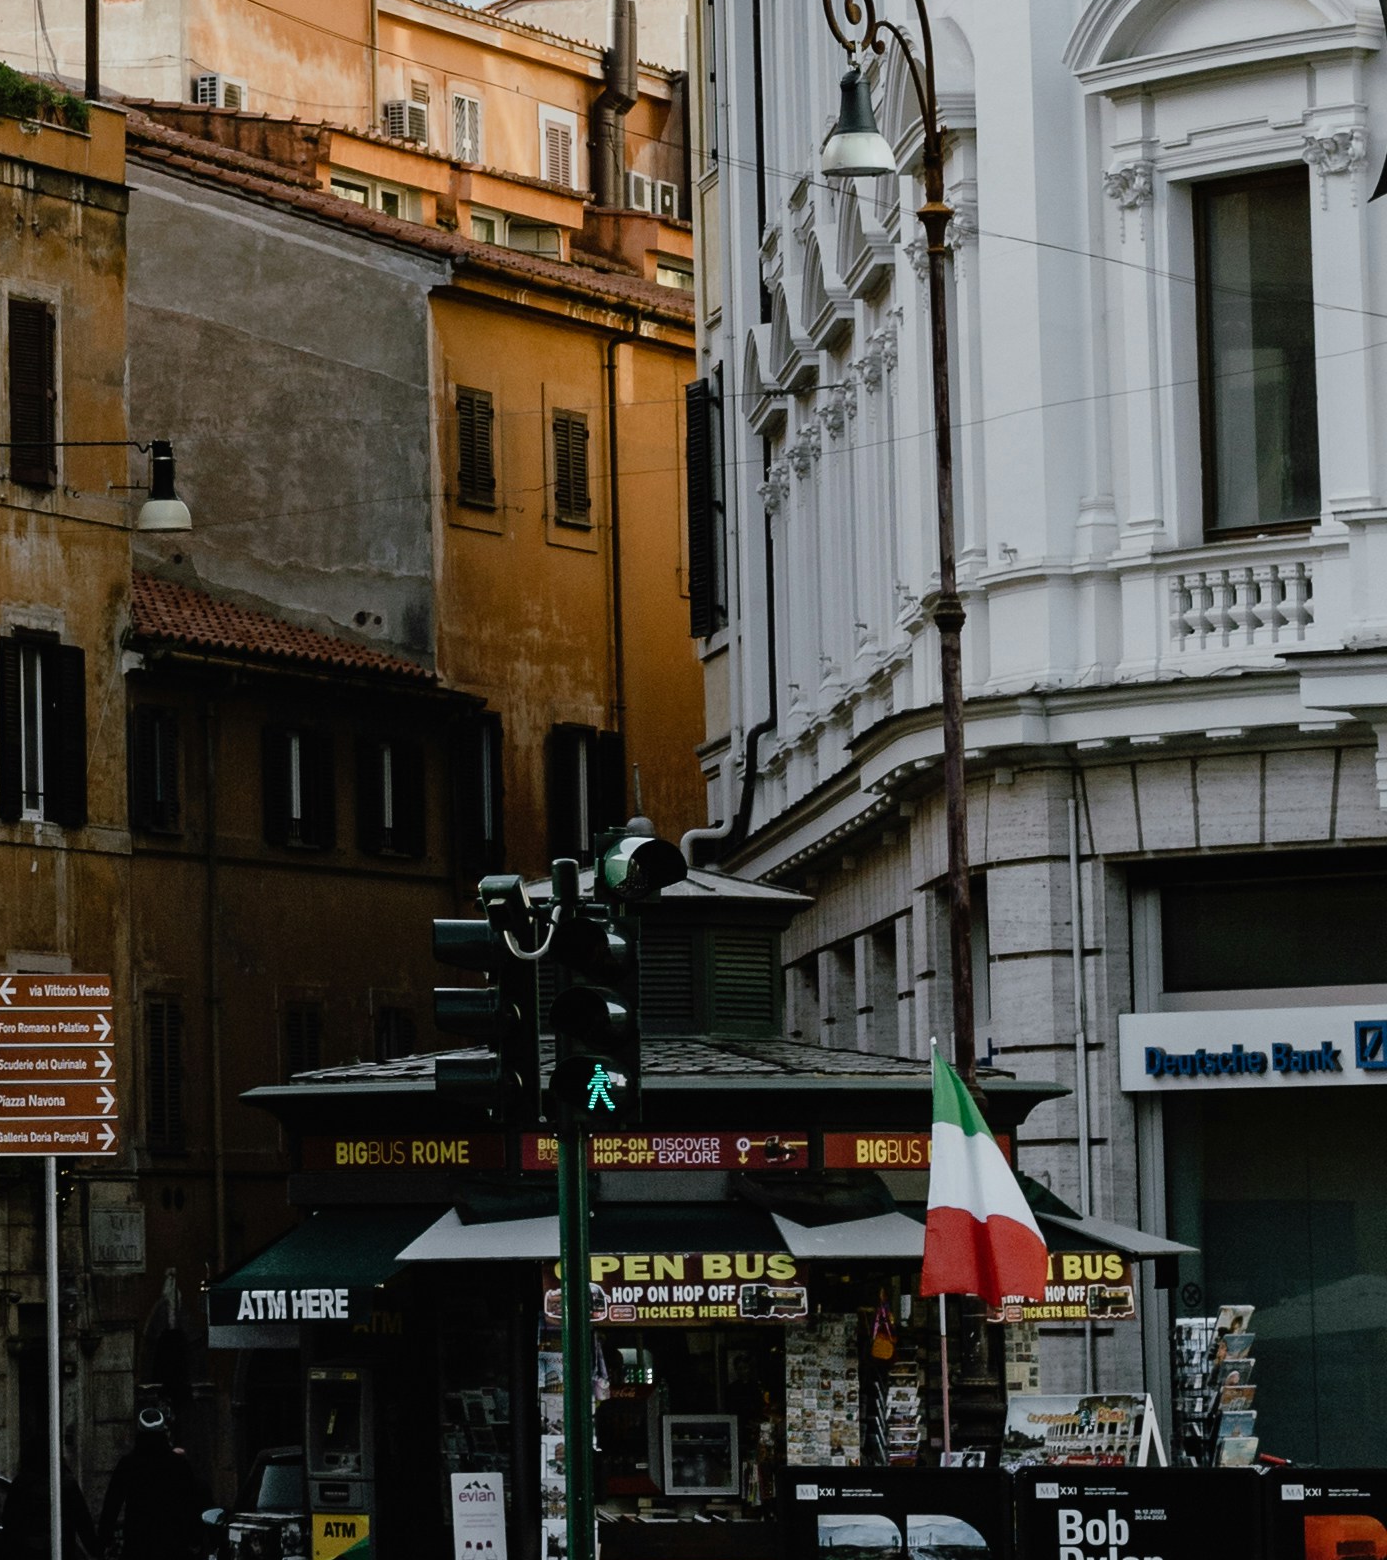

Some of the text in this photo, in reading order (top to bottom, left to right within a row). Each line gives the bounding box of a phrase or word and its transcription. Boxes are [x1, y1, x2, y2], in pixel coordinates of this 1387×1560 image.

[29, 984, 111, 997] via Vittorio Veneto
[18, 1023, 50, 1033] Romano
[51, 1025, 57, 1033] e
[58, 1022, 90, 1034] Palatino
[35, 1057, 49, 1070] del
[50, 1057, 87, 1071] Quirinale
[1144, 1041, 1341, 1075] Deutsche Bank
[28, 1094, 66, 1107] Navona
[30, 1131, 52, 1143] Doria
[537, 1139, 559, 1150] BIG
[593, 1138, 721, 1151] HOP-ON DISCOVER
[411, 1140, 470, 1164] ROME
[593, 1151, 721, 1164] HOP-OFF EXPLORE
[554, 1254, 798, 1281] PEN BUS
[1062, 1254, 1124, 1281] BUS
[611, 1284, 737, 1303] HOP ON HOP OFF
[1067, 1285, 1086, 1302] OFF
[237, 1288, 349, 1320] ATM HERE
[636, 1305, 695, 1319] TICKETS
[699, 1304, 738, 1319] HERE
[1022, 1306, 1062, 1319] TICKETS
[1064, 1305, 1087, 1319] HERE
[458, 1490, 497, 1503] evian
[323, 1521, 357, 1539] ATM
[1057, 1508, 1130, 1546] Bob
